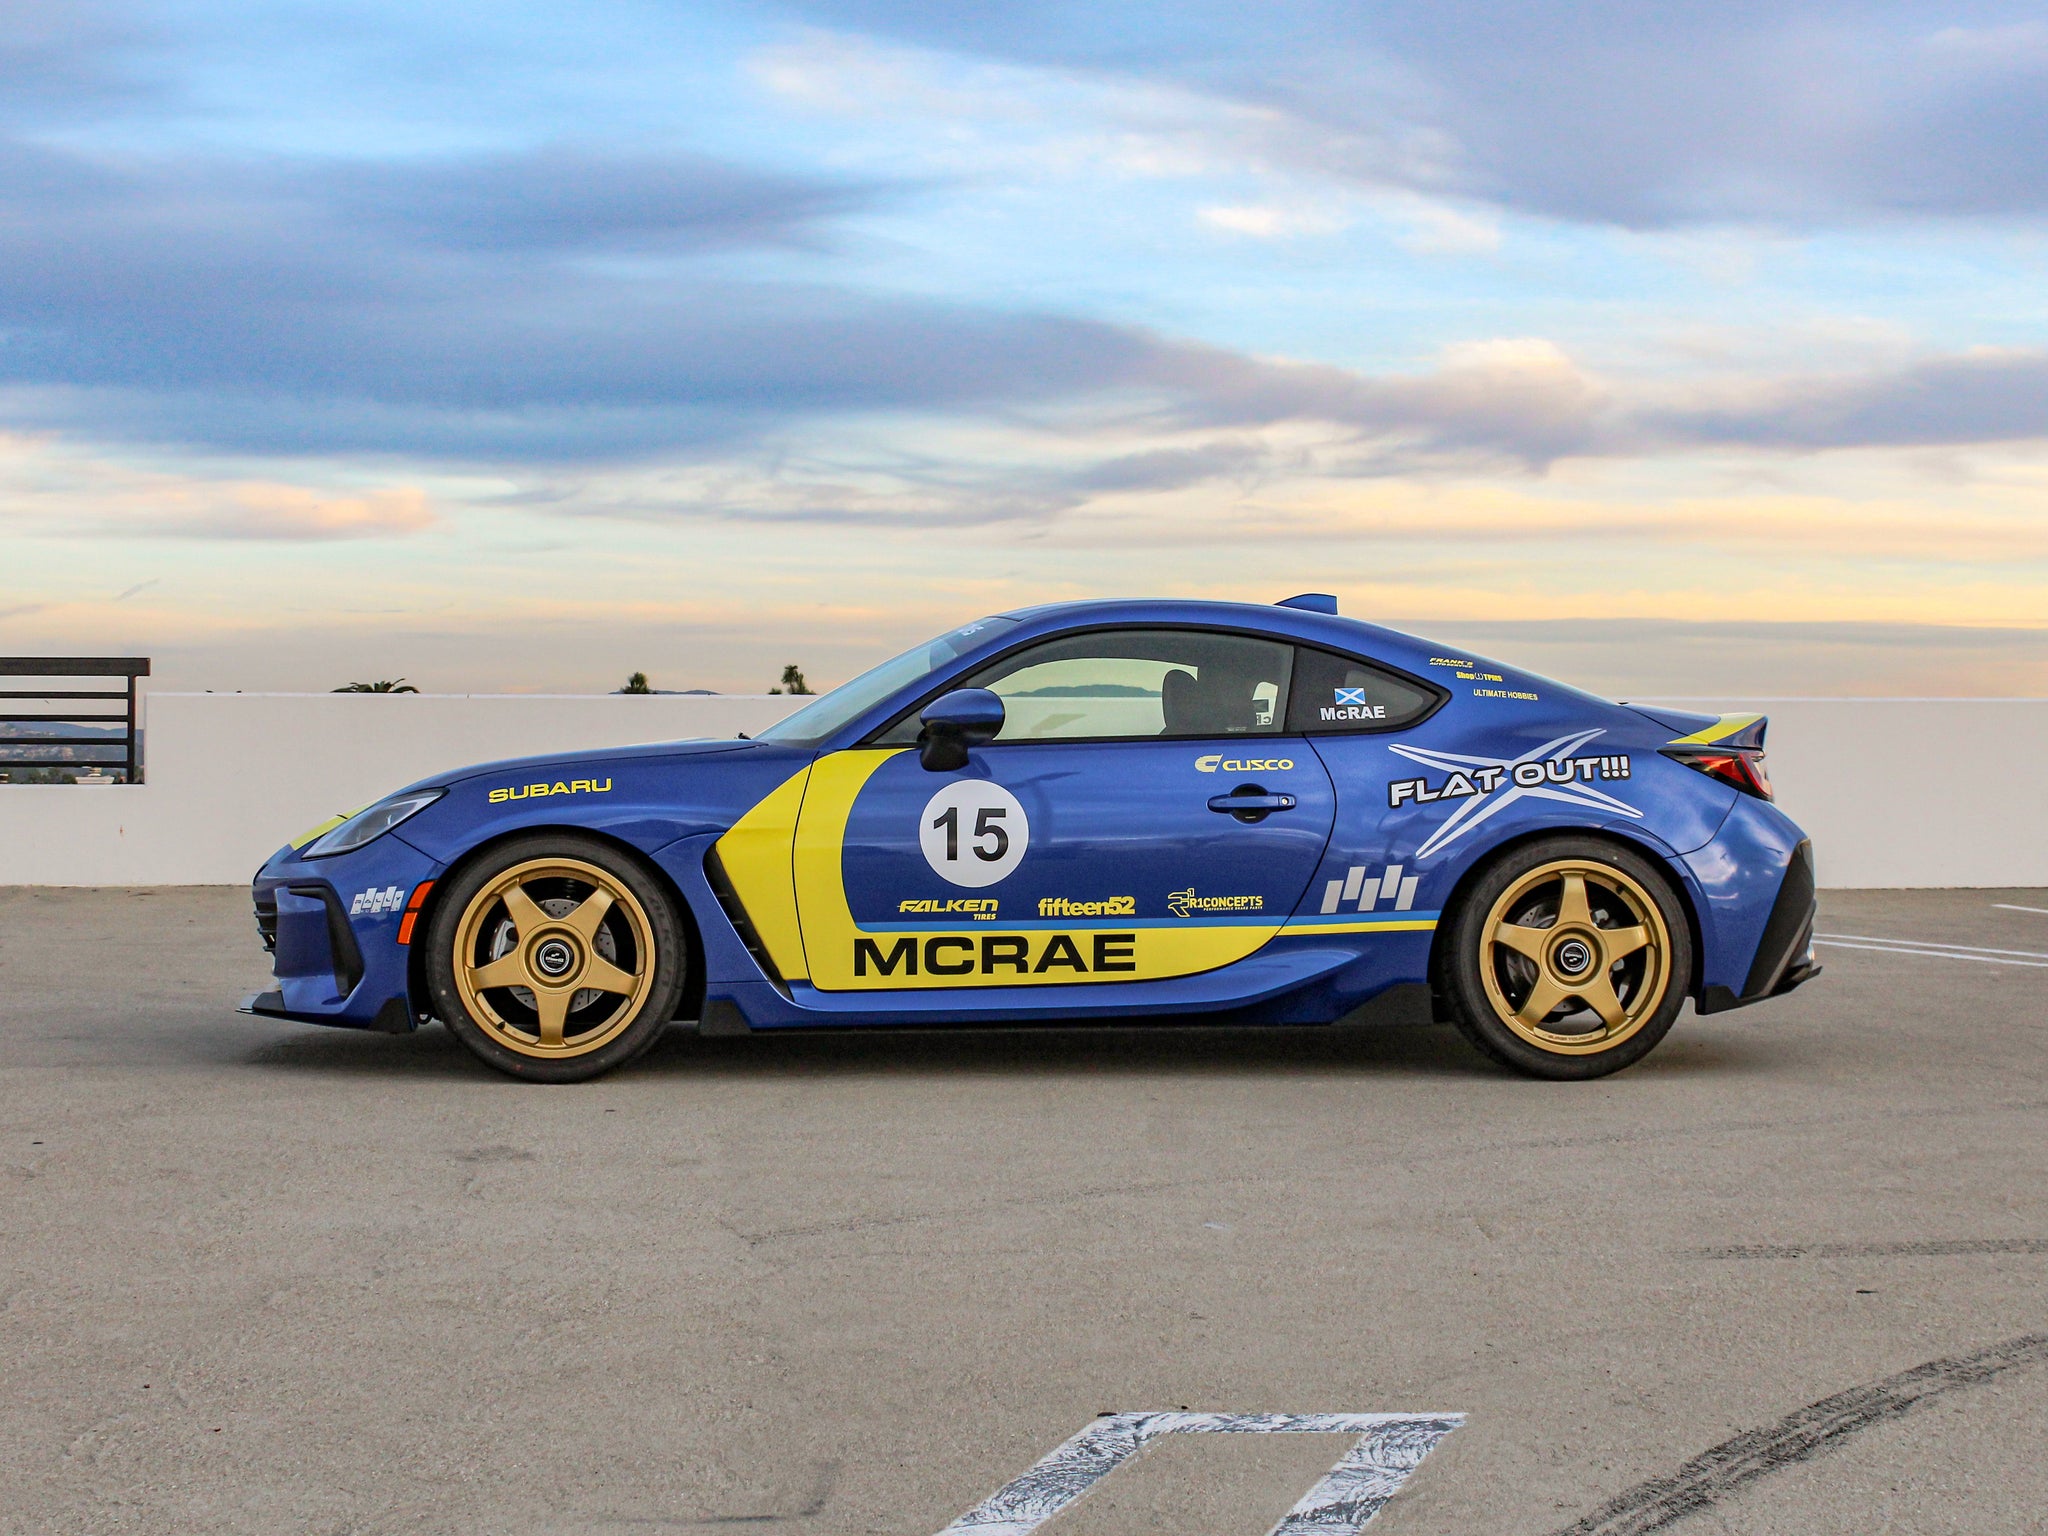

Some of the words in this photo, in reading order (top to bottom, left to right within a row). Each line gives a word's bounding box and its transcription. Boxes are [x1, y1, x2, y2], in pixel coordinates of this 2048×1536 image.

[1473, 689, 1506, 698] ULTIMATE
[1507, 691, 1538, 701] HOBBIES
[1320, 705, 1386, 721] McRAE
[488, 778, 612, 803] SUBARU
[1389, 766, 1503, 807] FLAT
[1513, 755, 1630, 787] OUT!!!
[933, 807, 1009, 862] 15
[898, 899, 999, 913] FALKEN
[1038, 896, 1136, 917] fifteen52
[973, 913, 997, 921] TIRES
[854, 933, 1136, 976] MCRAE
